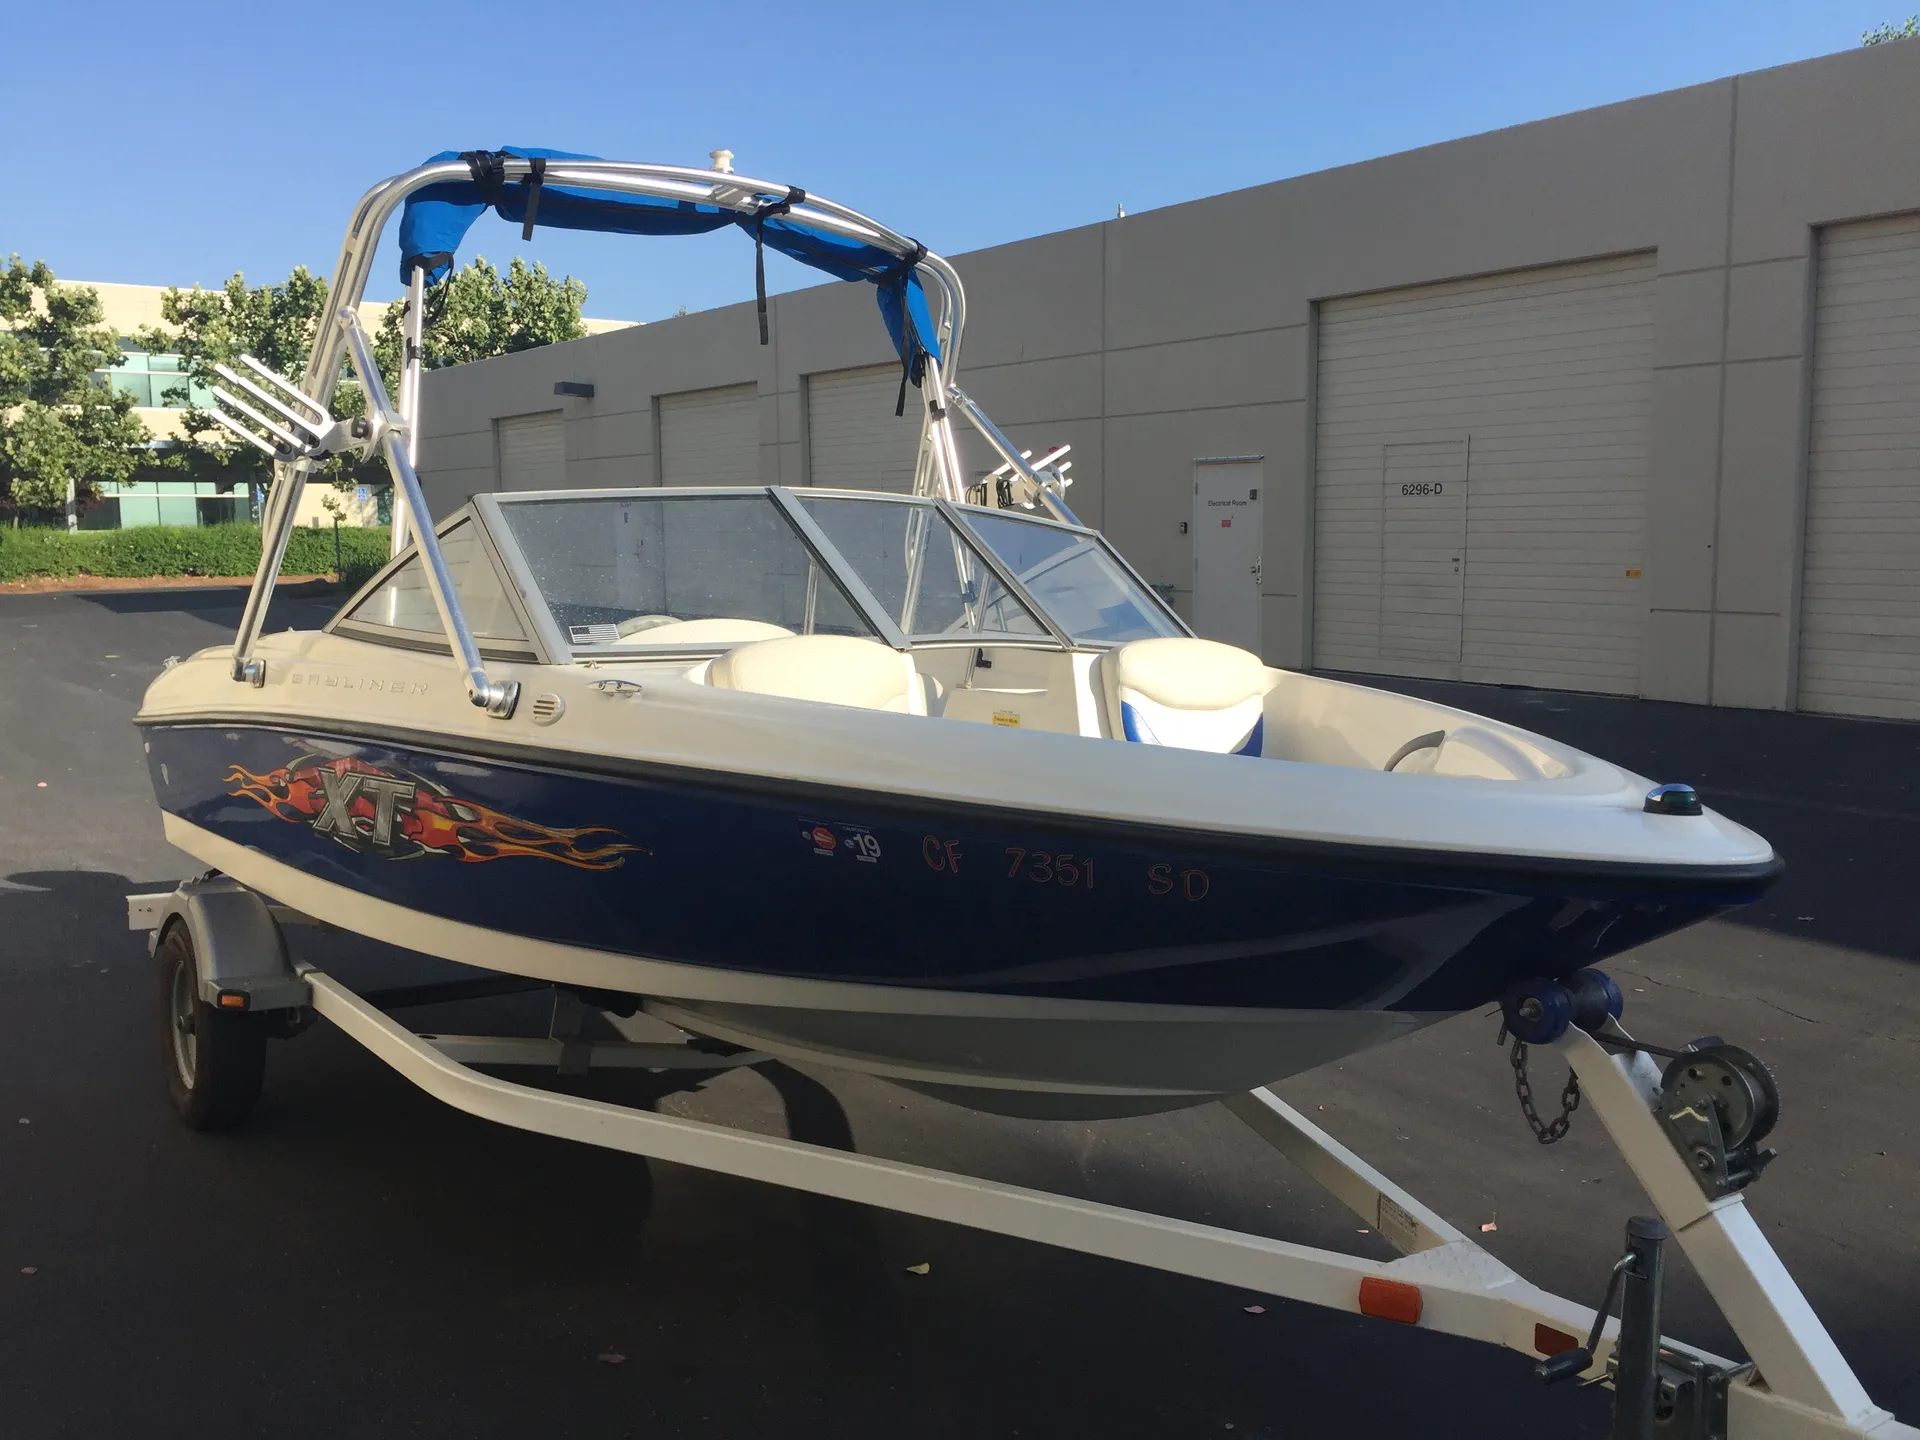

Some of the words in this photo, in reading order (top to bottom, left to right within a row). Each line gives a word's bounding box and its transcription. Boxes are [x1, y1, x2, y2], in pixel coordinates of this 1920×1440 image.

[1401, 482, 1443, 496] 6296-D
[312, 766, 417, 848] XT
[853, 833, 881, 858] 19
[922, 834, 963, 873] CF
[1004, 846, 1096, 890] 7351
[1147, 862, 1211, 901] SD
